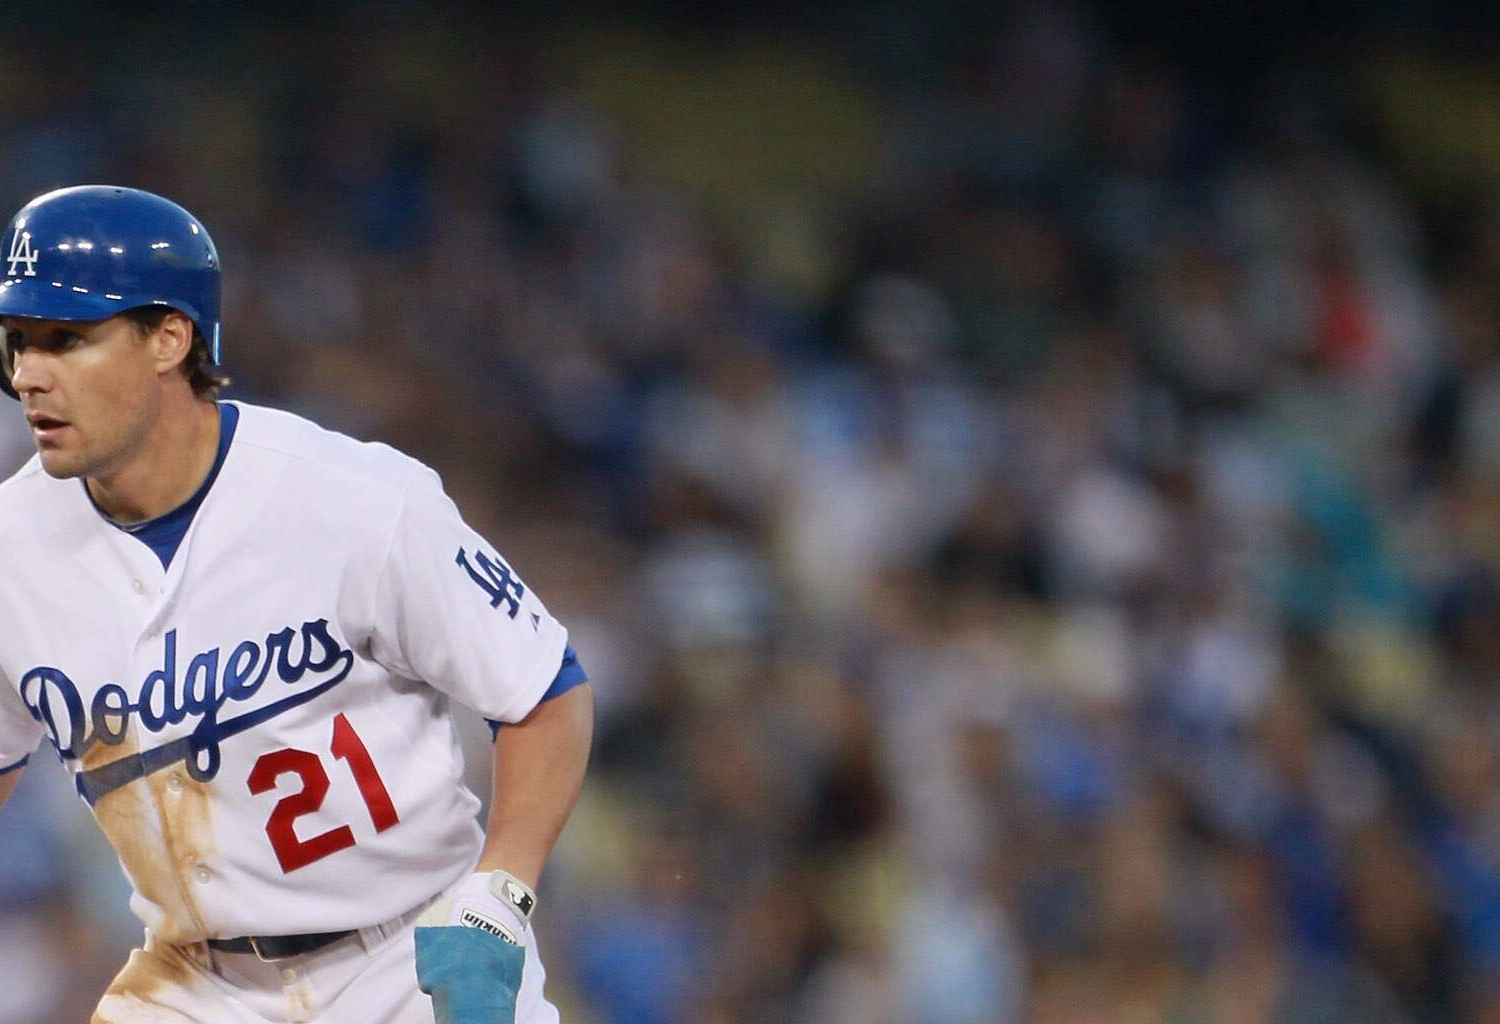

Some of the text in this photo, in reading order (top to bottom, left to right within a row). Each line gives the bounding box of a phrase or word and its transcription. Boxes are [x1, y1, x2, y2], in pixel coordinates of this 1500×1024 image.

[7, 218, 39, 276] LA
[455, 545, 524, 620] LA
[20, 618, 354, 784] Dodgers
[247, 712, 400, 874] 21
[464, 913, 517, 945] anklin
